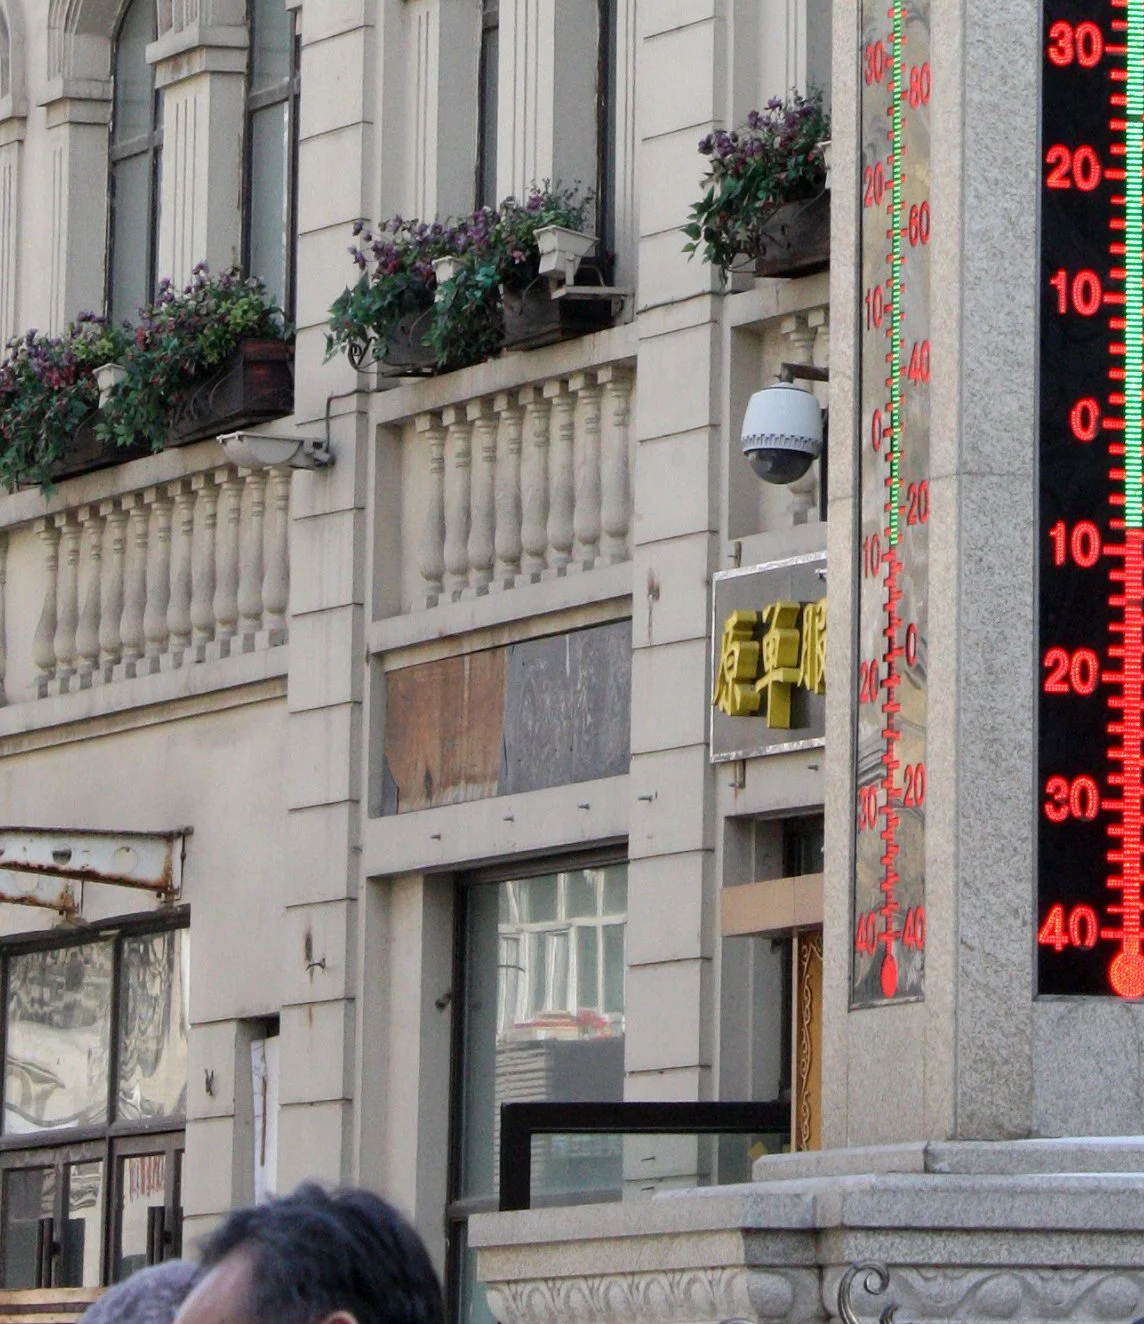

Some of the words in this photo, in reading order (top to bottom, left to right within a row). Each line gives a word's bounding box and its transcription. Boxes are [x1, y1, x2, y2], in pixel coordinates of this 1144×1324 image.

[865, 40, 886, 87] 30
[1048, 21, 1104, 68] 30
[908, 62, 931, 108] 80
[864, 163, 885, 209] 20
[1045, 145, 1101, 191] 20
[908, 200, 931, 247] 60
[865, 287, 884, 332] 10
[1050, 269, 1101, 317] 10
[907, 338, 931, 386] 40
[870, 409, 883, 451] 0
[1070, 397, 1098, 441] 0
[906, 479, 930, 525] 20
[862, 533, 881, 578] 10
[1049, 521, 1099, 567] 10
[713, 596, 827, 729] 原单服
[905, 621, 920, 666] 0
[859, 659, 880, 704] 20
[1044, 649, 1098, 695] 20
[857, 786, 879, 831] 30
[902, 763, 927, 808] 20
[1044, 777, 1098, 823] 30
[855, 911, 878, 956] 40
[901, 905, 926, 951] 40
[1038, 905, 1098, 951] 40
